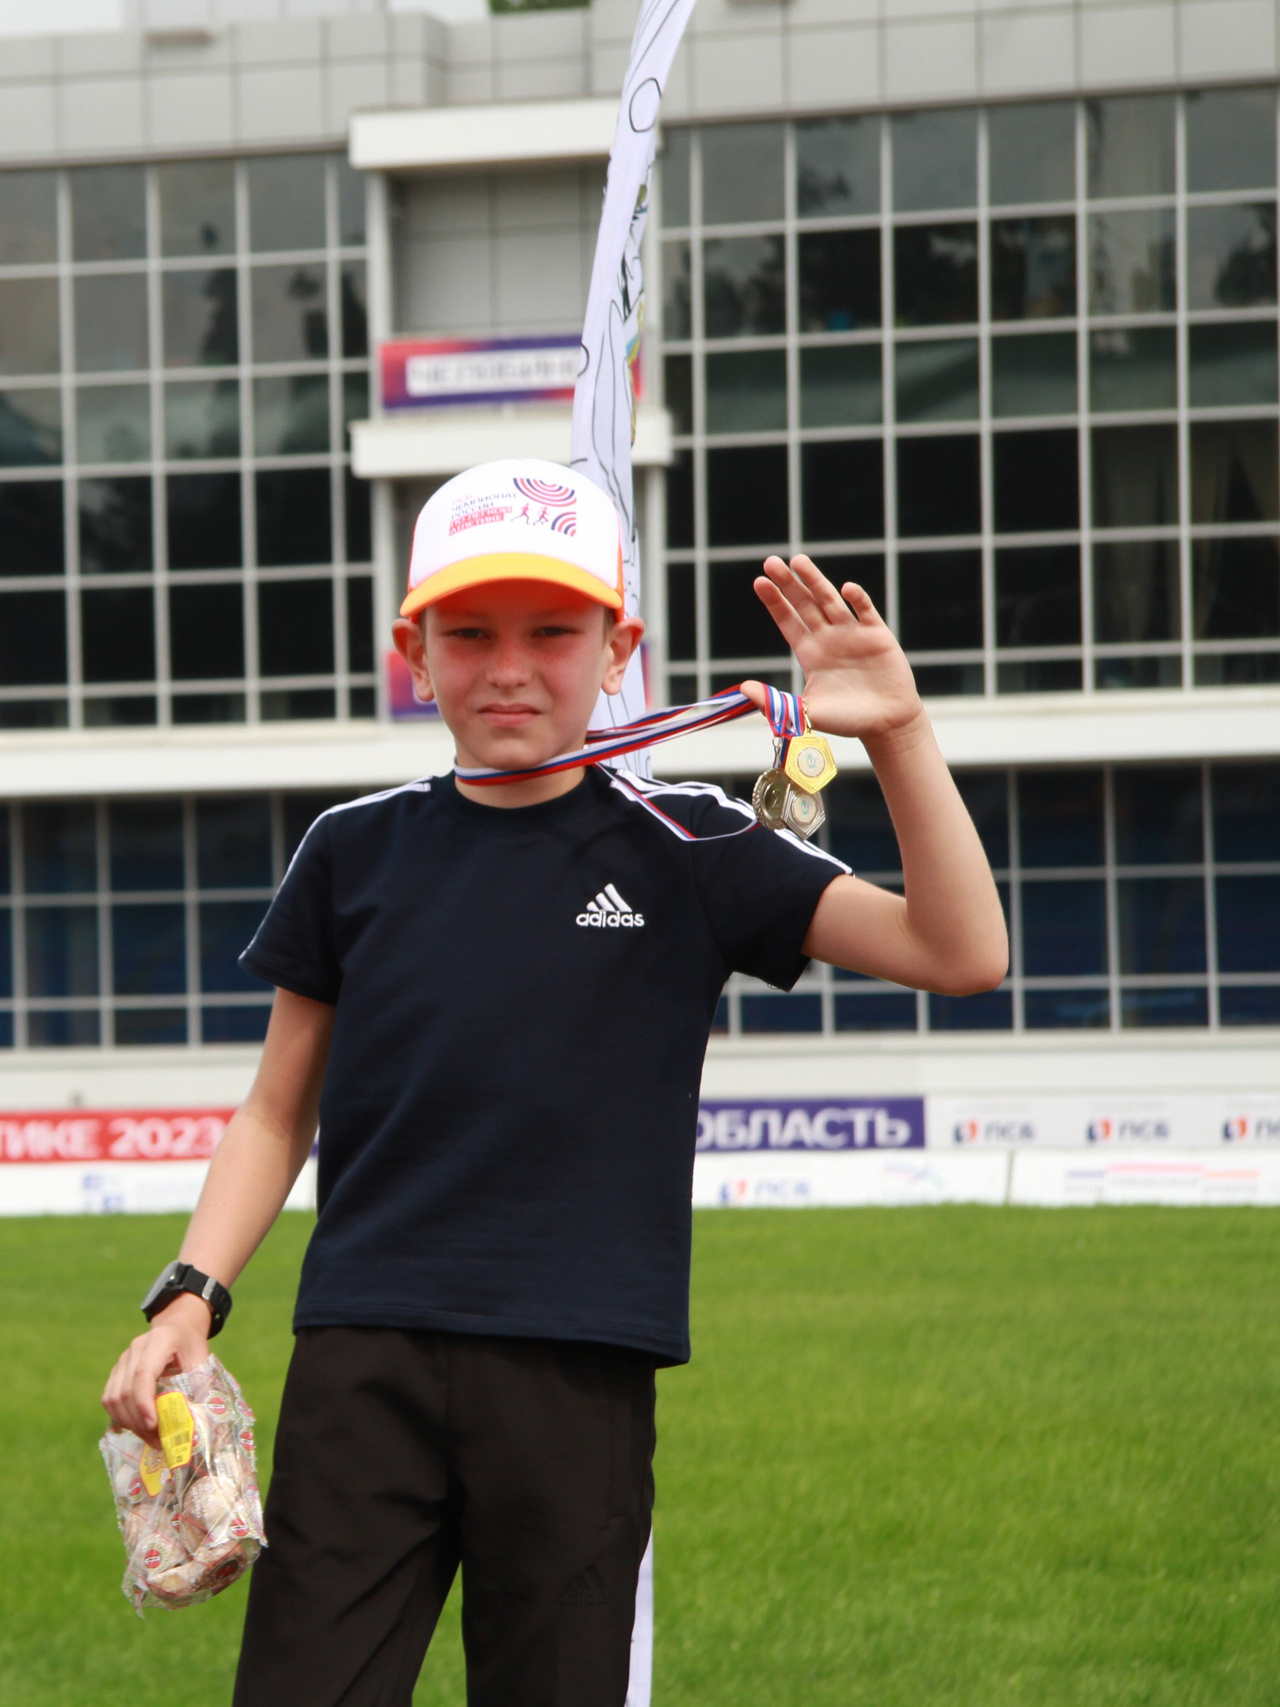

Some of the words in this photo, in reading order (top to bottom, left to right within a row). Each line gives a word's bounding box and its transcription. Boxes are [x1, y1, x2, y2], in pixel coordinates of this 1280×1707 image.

[451, 493, 516, 511] ЧЕМПИОНАТ
[451, 502, 494, 520] РОССИИ
[771, 788, 781, 809] 2
[576, 909, 645, 927] adidas
[696, 1106, 913, 1149] ОБЛАСТЬ
[109, 1117, 225, 1158] 2023
[554, 1589, 616, 1607] adidas
